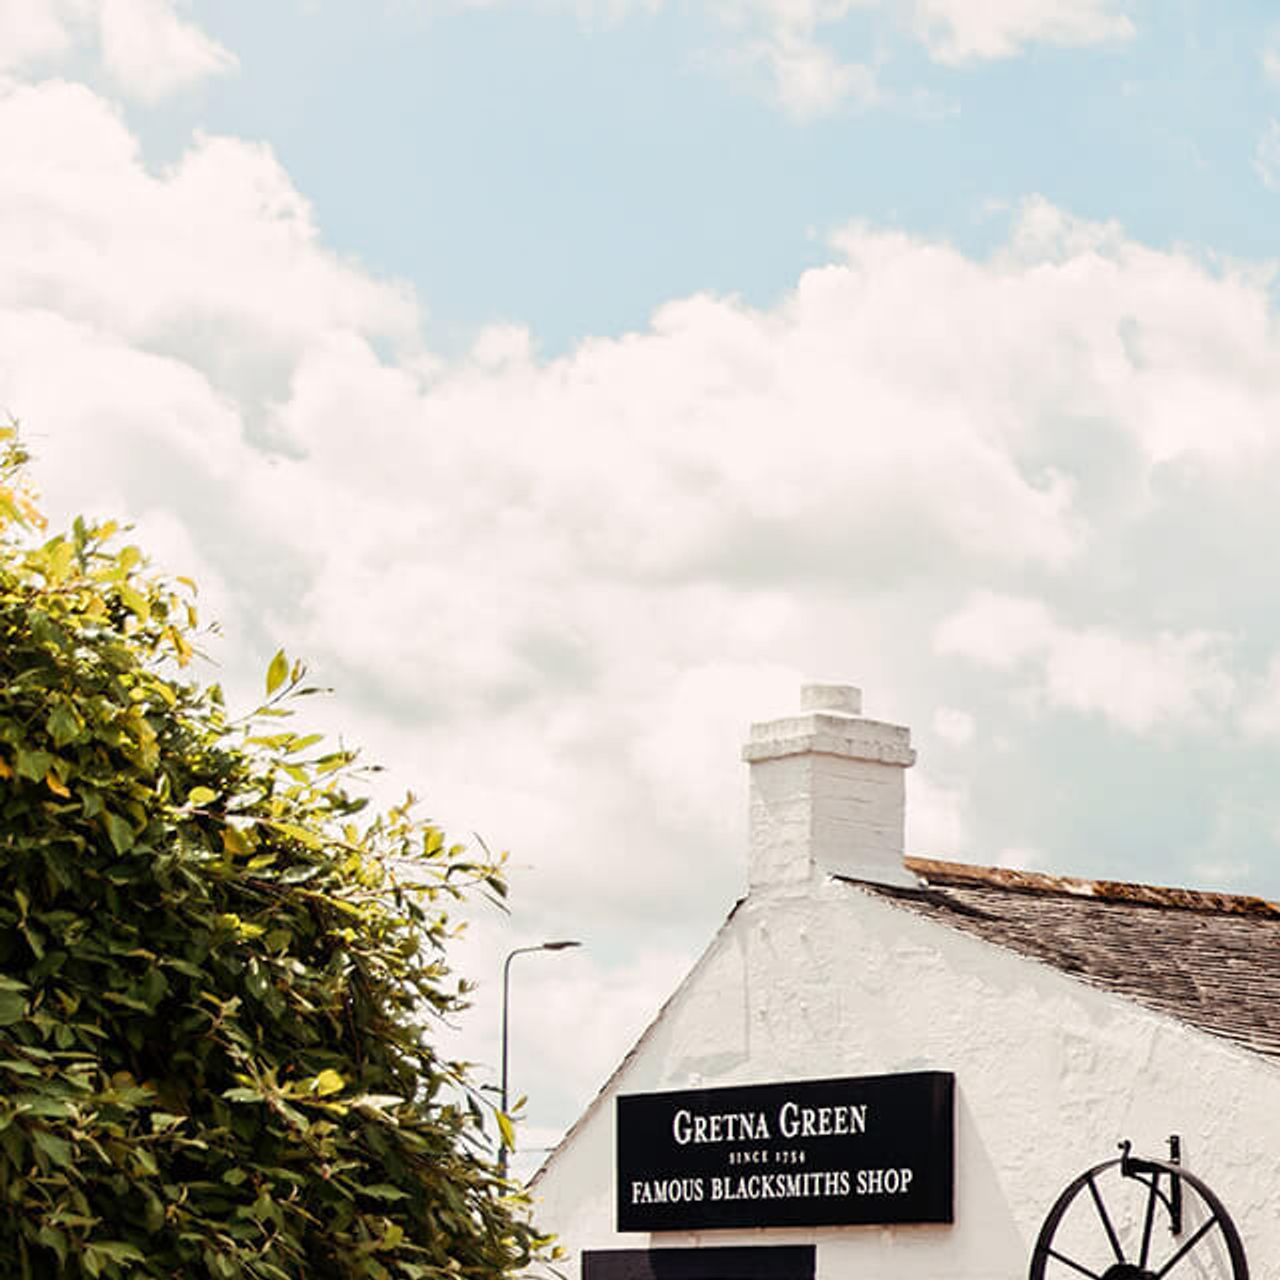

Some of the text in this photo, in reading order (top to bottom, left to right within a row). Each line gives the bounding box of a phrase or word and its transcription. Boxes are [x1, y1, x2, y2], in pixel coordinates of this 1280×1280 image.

[672, 1102, 868, 1145] GRETNA GREEN
[729, 1150, 768, 1164] SINCE
[631, 1168, 913, 1204] FAMOUS BLACKSMITHS SHOP
